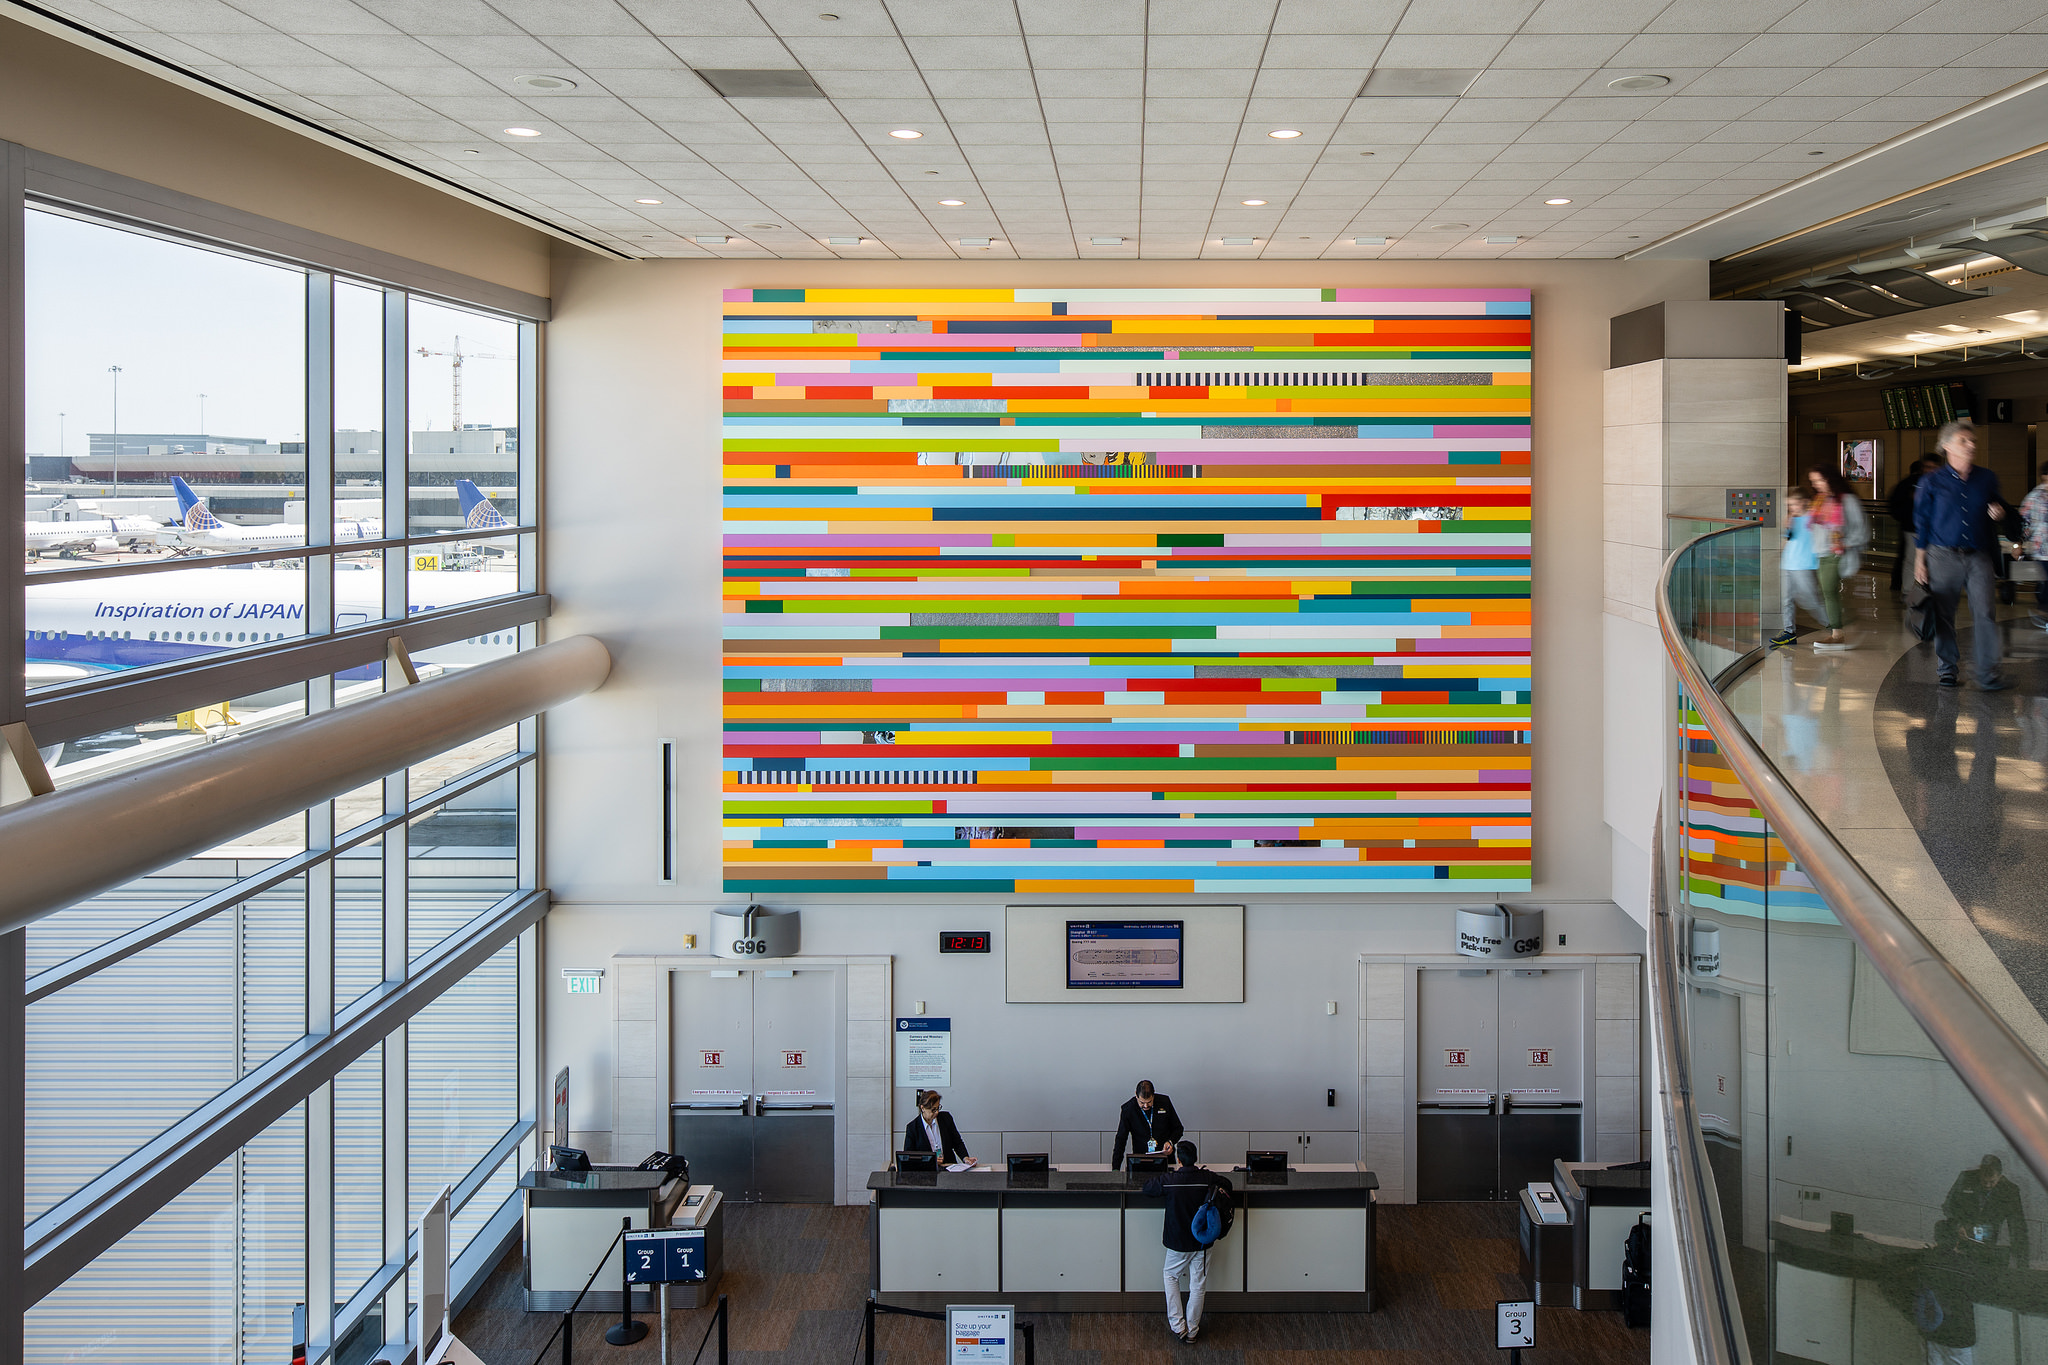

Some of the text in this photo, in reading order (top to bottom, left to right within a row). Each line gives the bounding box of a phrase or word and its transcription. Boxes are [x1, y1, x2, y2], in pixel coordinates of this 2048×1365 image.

[416, 557, 437, 571] 94
[94, 602, 304, 621] Inspiration of JAPAN
[951, 937, 984, 949] 12:13
[1461, 932, 1502, 945] Duty Free
[1513, 936, 1540, 953] G96
[732, 939, 767, 954] G96
[1461, 941, 1491, 954] Pick-up
[571, 977, 597, 993] EXIT
[641, 1255, 651, 1269] 2
[681, 1253, 690, 1268] 1
[955, 1322, 968, 1330] Size
[1510, 1318, 1522, 1335] 3
